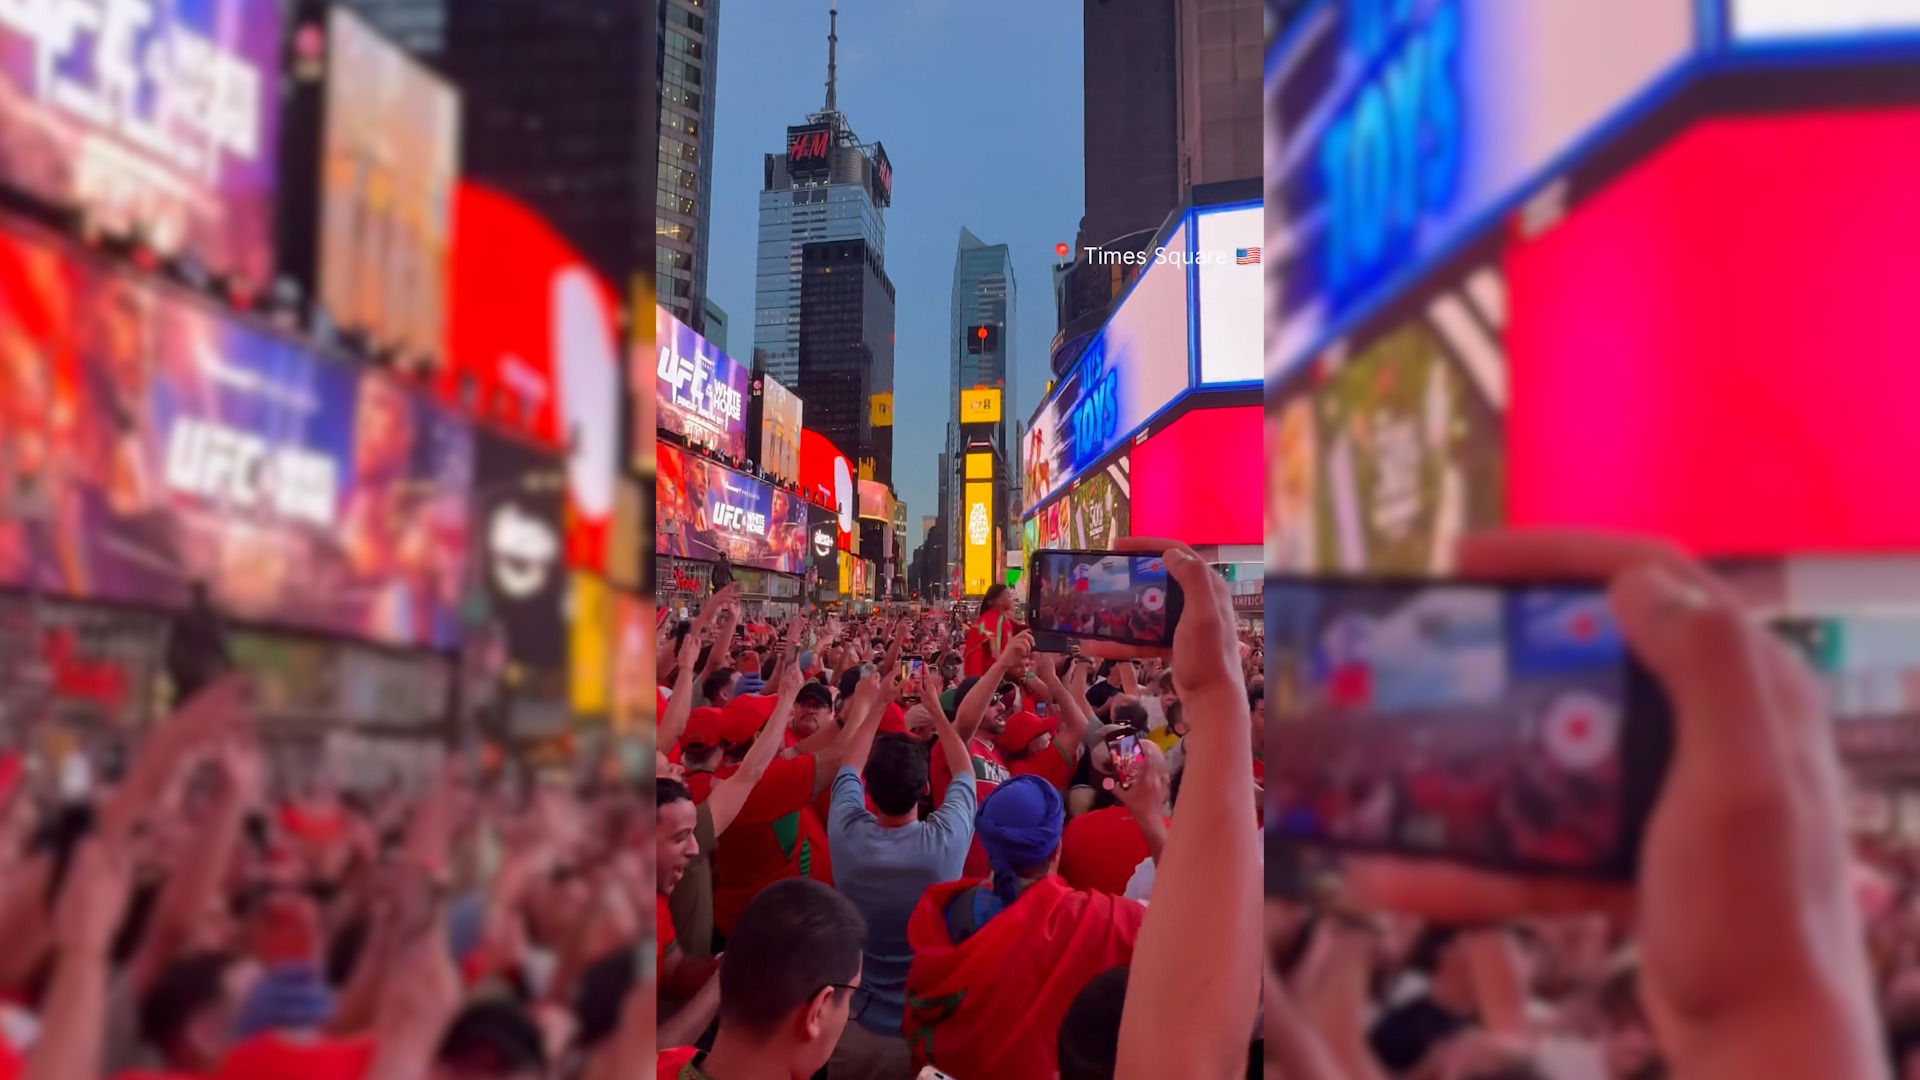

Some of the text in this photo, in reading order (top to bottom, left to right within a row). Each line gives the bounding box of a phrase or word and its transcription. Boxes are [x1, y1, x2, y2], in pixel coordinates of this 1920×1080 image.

[657, 346, 708, 402] UFC
[713, 393, 741, 421] HOUSE
[714, 378, 742, 407] WHITE
[1073, 367, 1116, 462] TOYS
[713, 501, 743, 530] UFC
